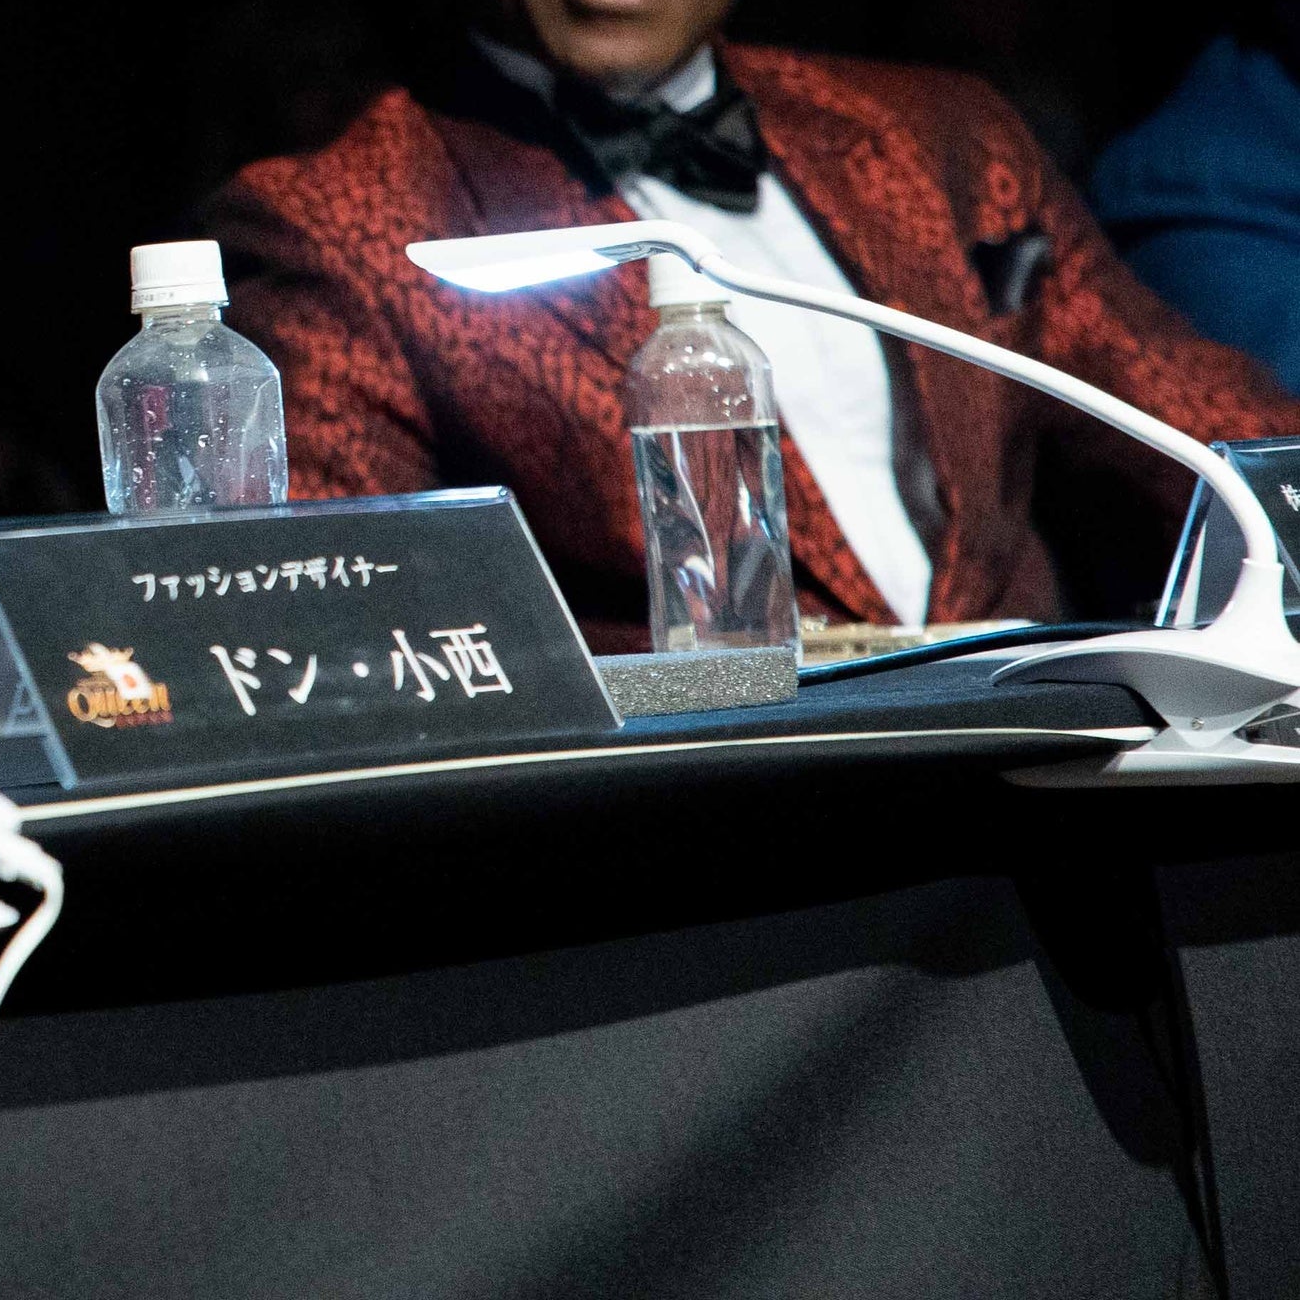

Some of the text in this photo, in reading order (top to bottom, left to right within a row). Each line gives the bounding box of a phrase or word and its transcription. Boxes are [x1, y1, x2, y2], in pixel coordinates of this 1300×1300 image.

[131, 555, 399, 603] ファッションデザイナー
[209, 623, 514, 717] ドン・小西
